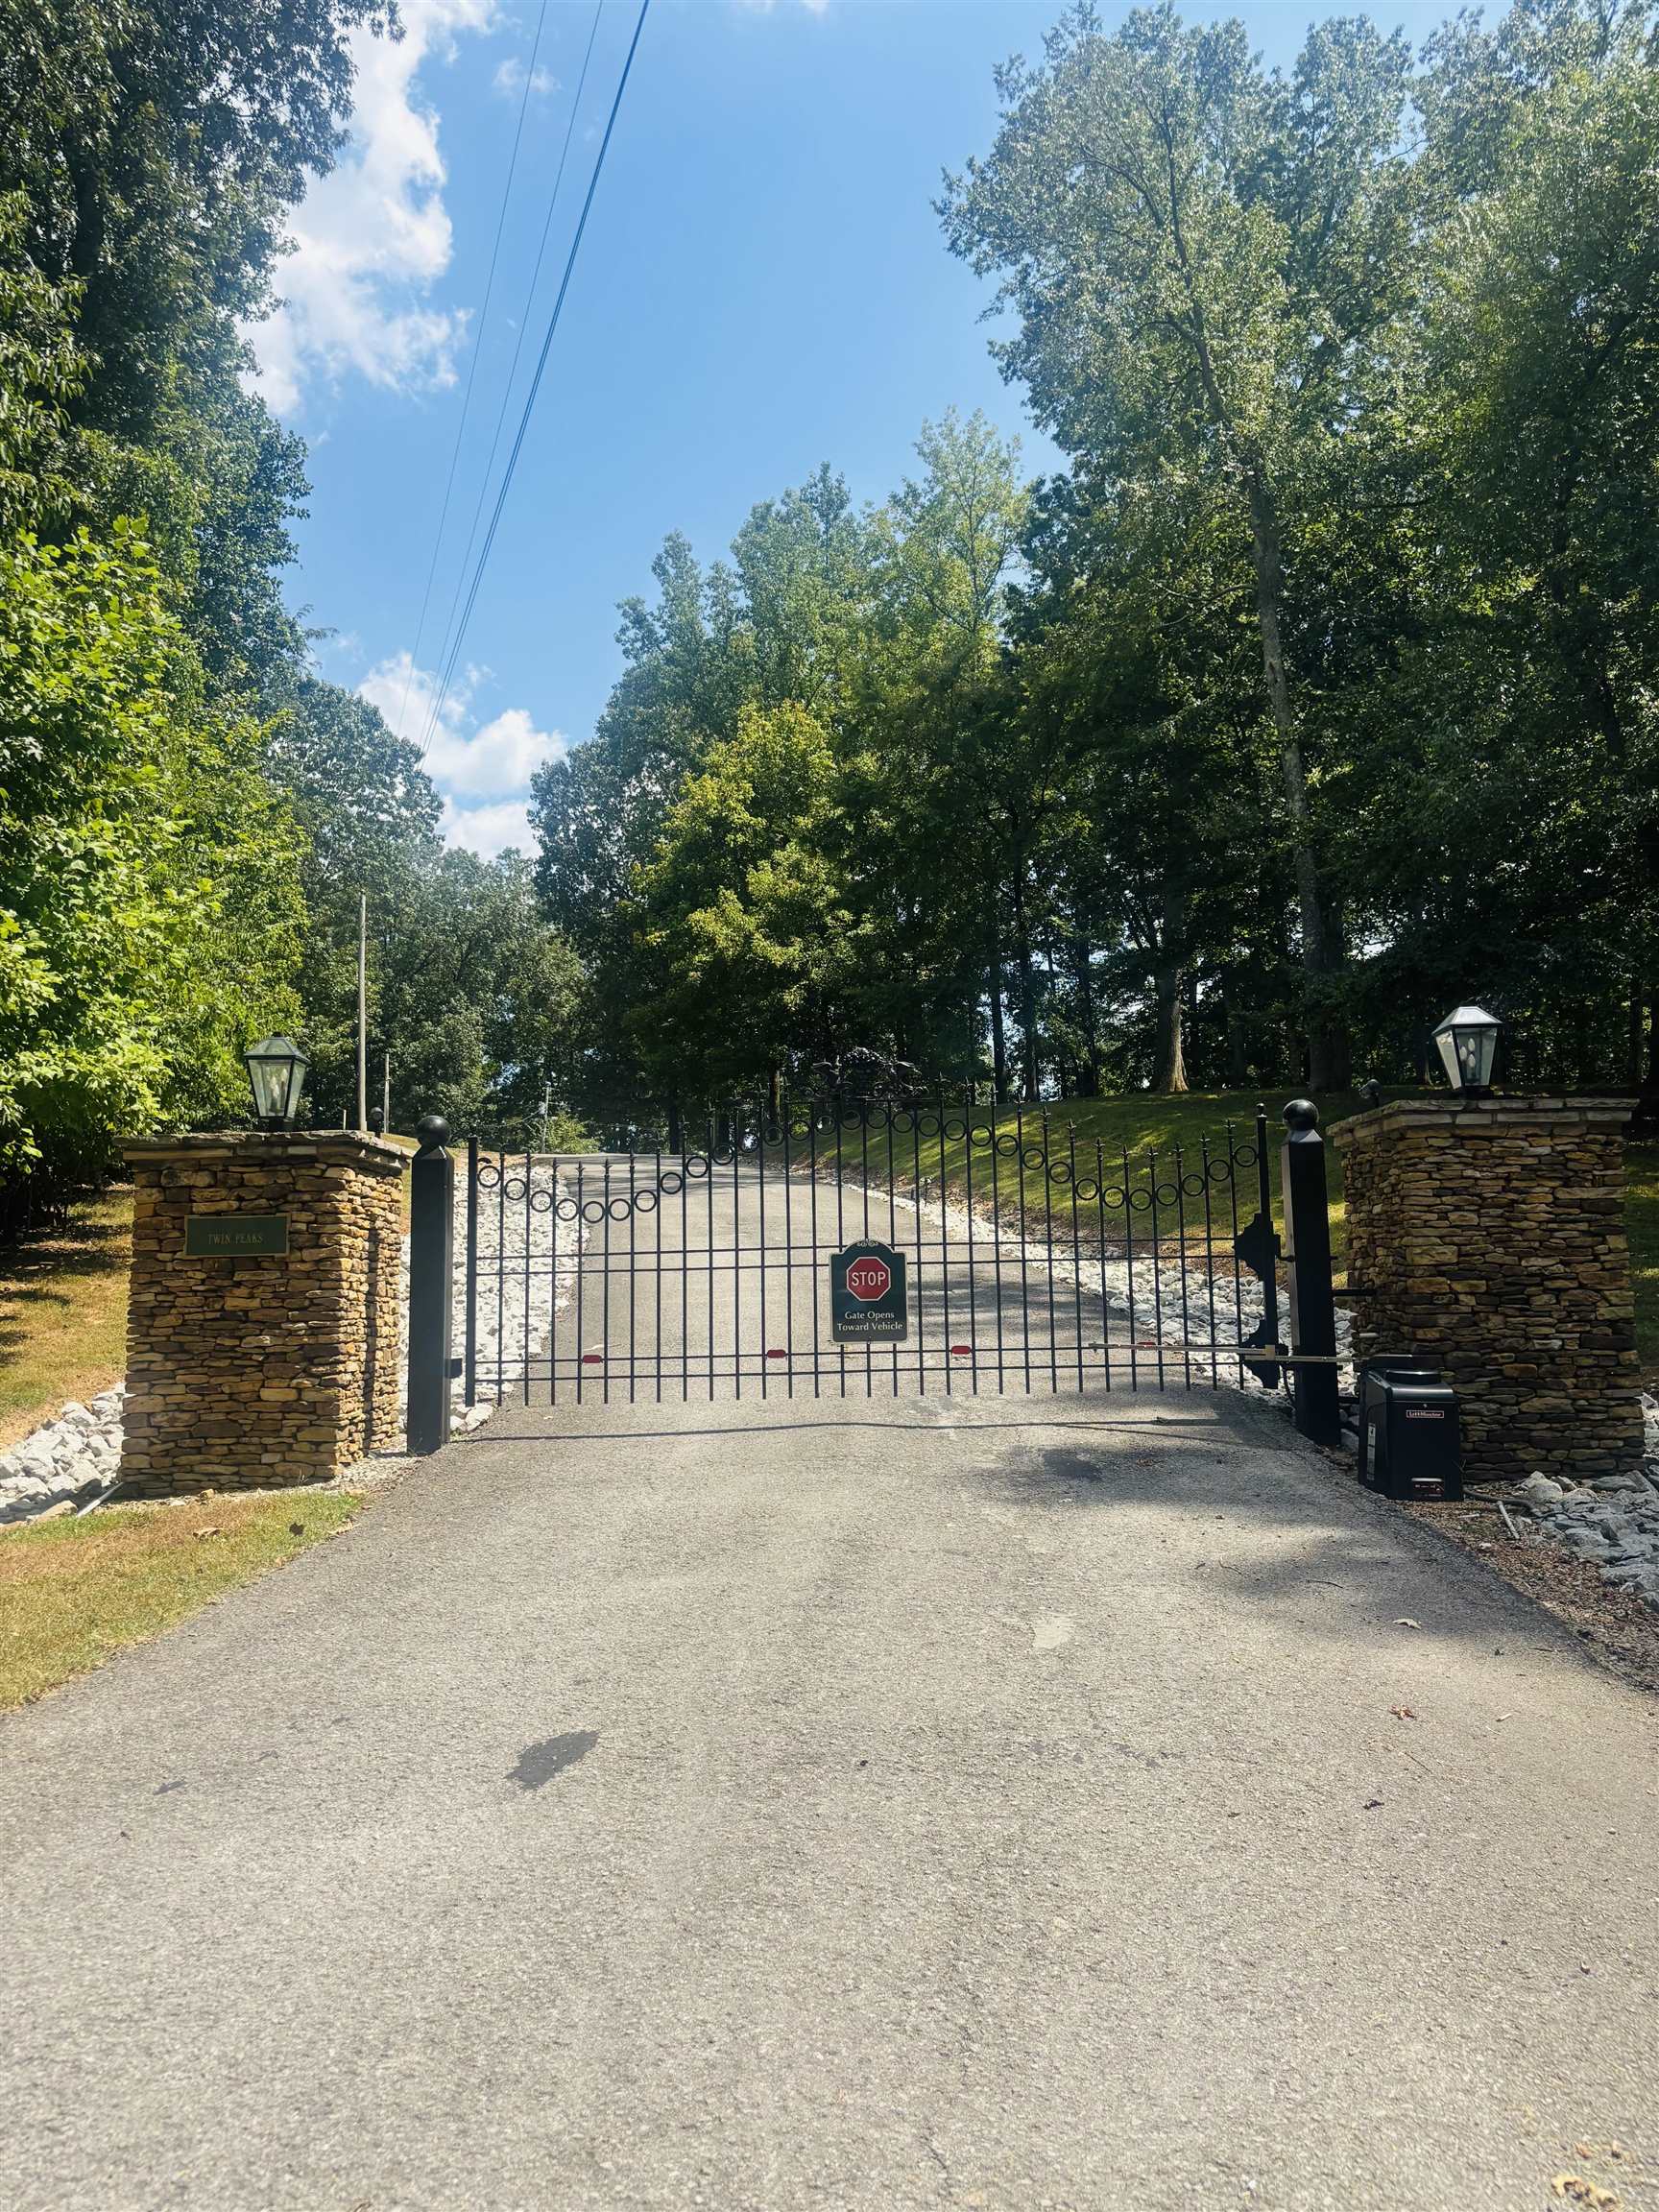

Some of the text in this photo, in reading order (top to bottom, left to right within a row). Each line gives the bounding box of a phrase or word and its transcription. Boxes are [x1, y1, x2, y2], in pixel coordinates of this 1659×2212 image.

[207, 1234, 263, 1244] TWIN PEAKS
[852, 1271, 885, 1286] STOP
[867, 1310, 895, 1321] Opens
[871, 1321, 903, 1331] Vehicle
